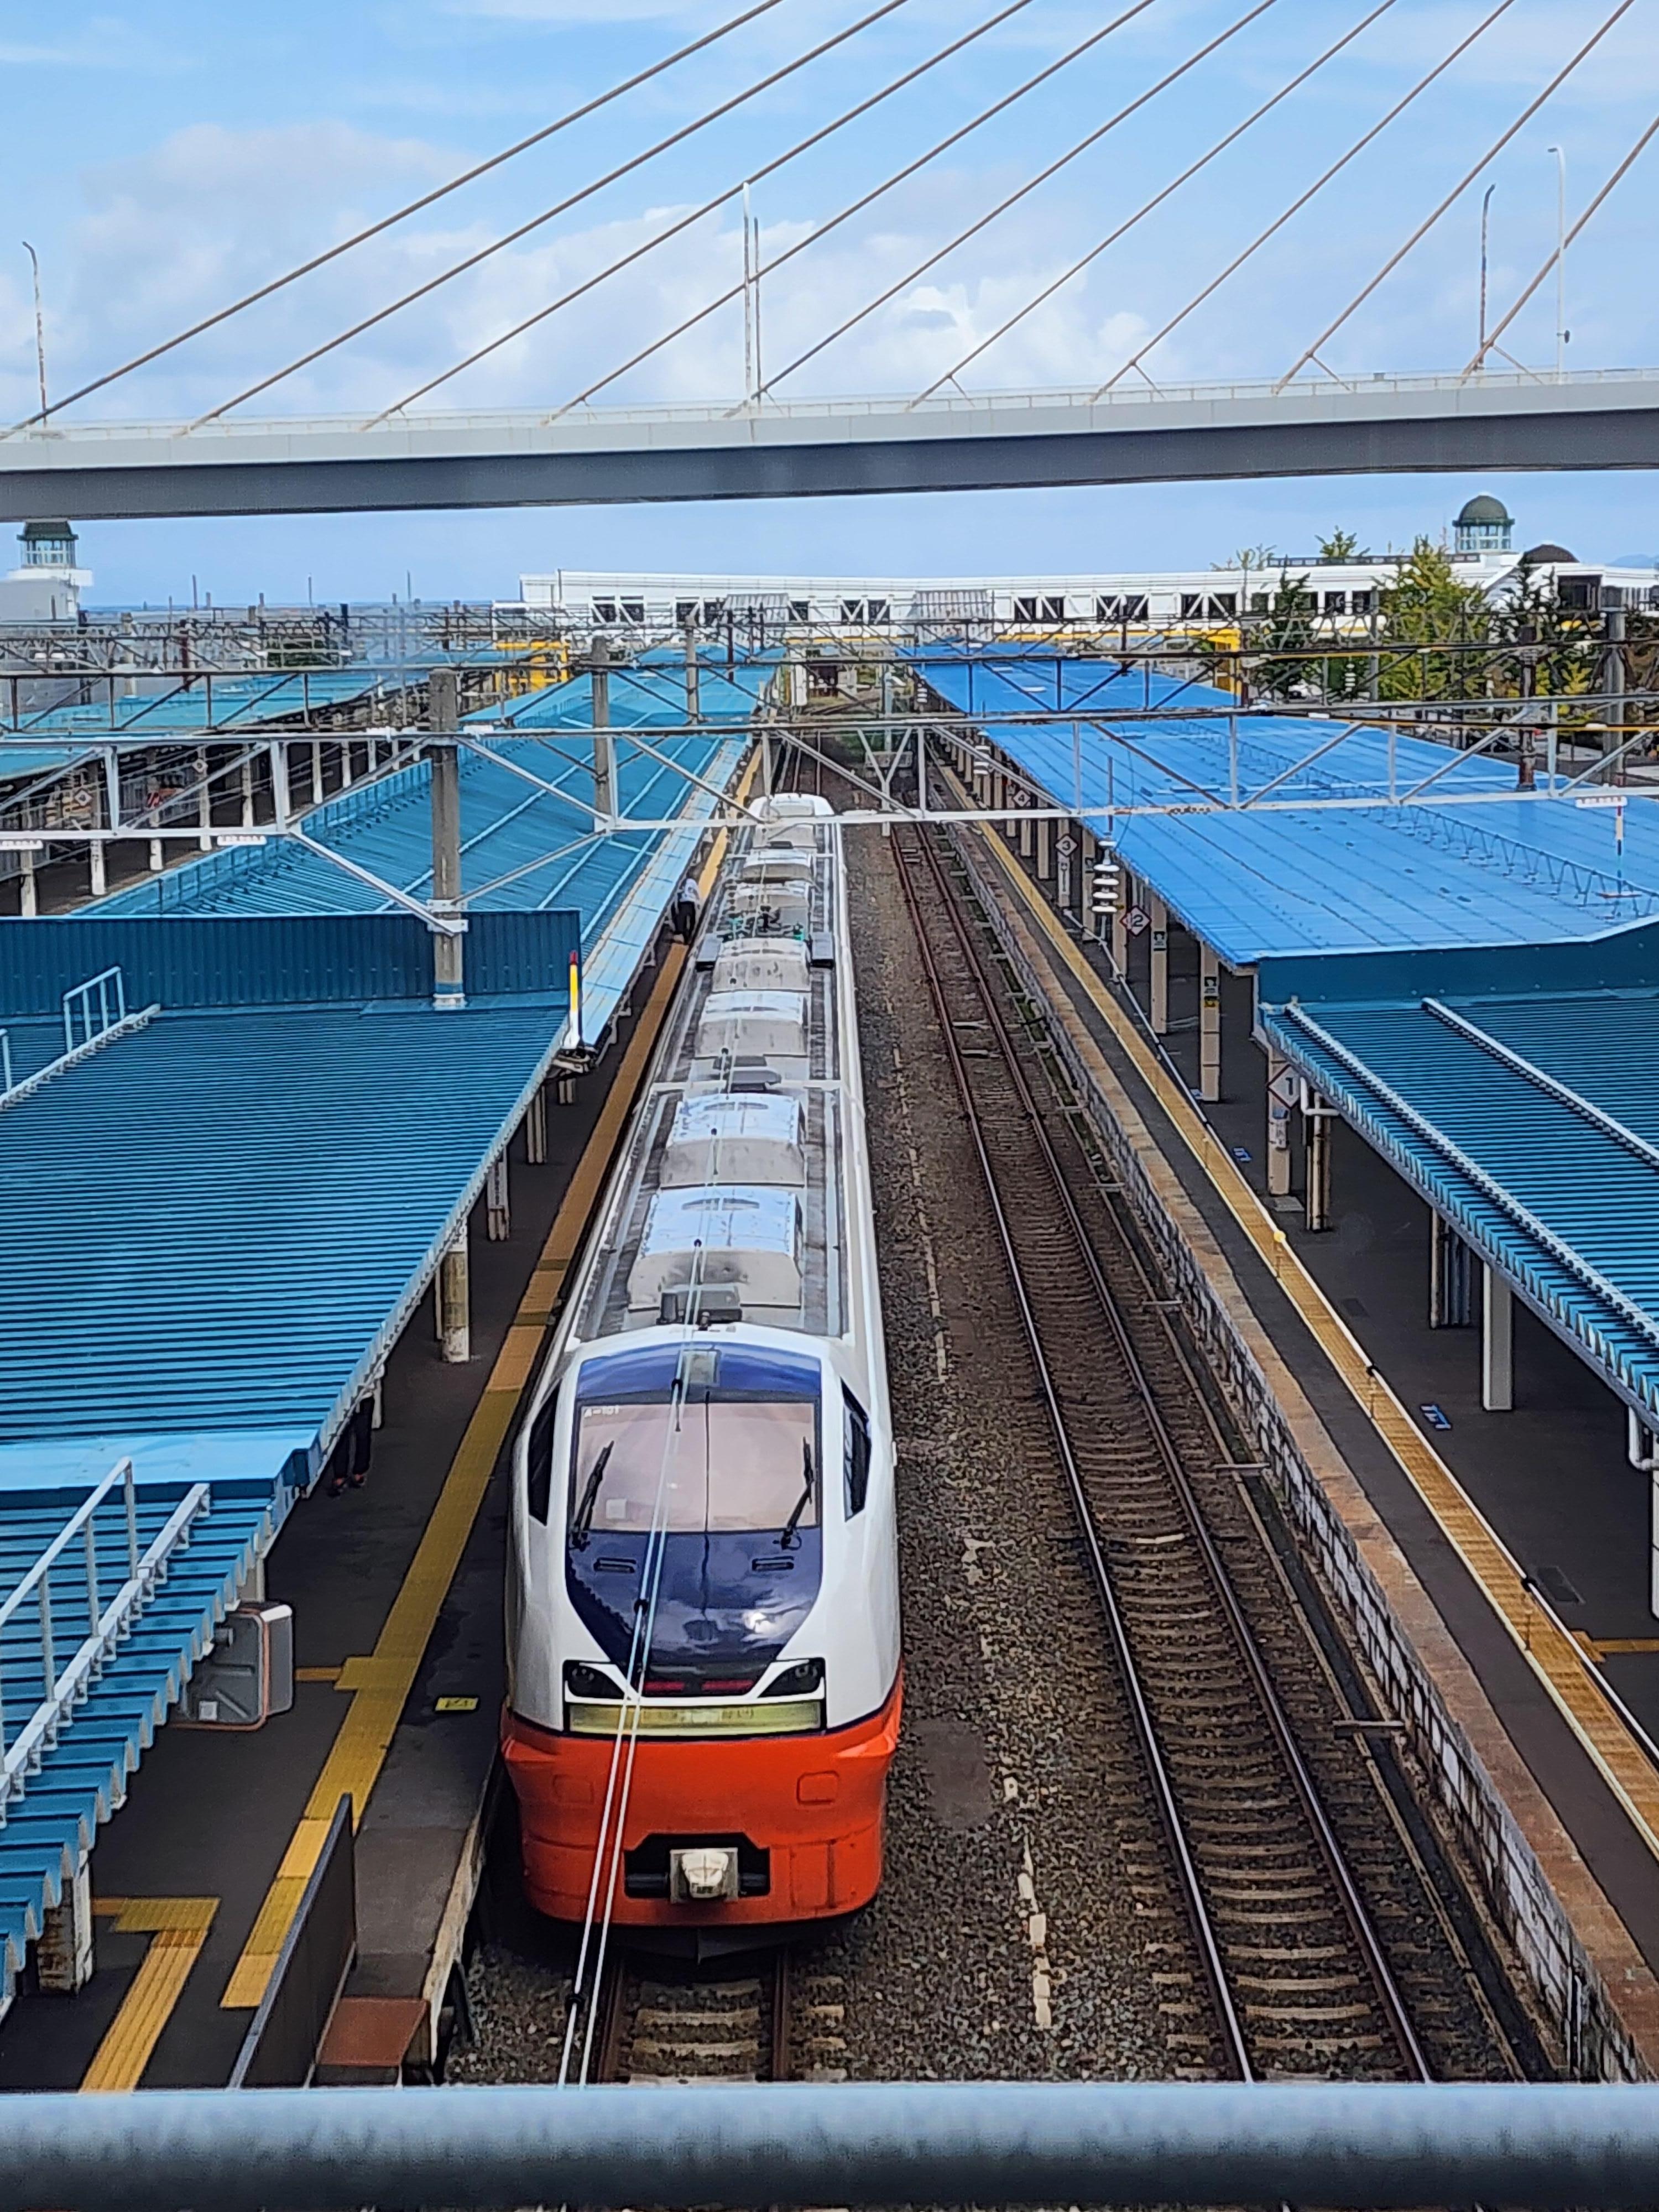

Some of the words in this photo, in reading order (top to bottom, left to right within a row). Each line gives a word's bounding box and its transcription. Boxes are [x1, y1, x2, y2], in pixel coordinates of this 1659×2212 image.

[1018, 794, 1025, 802] 4
[1061, 840, 1071, 851] 3
[1132, 914, 1144, 927] 2
[1285, 1077, 1294, 1096] 1
